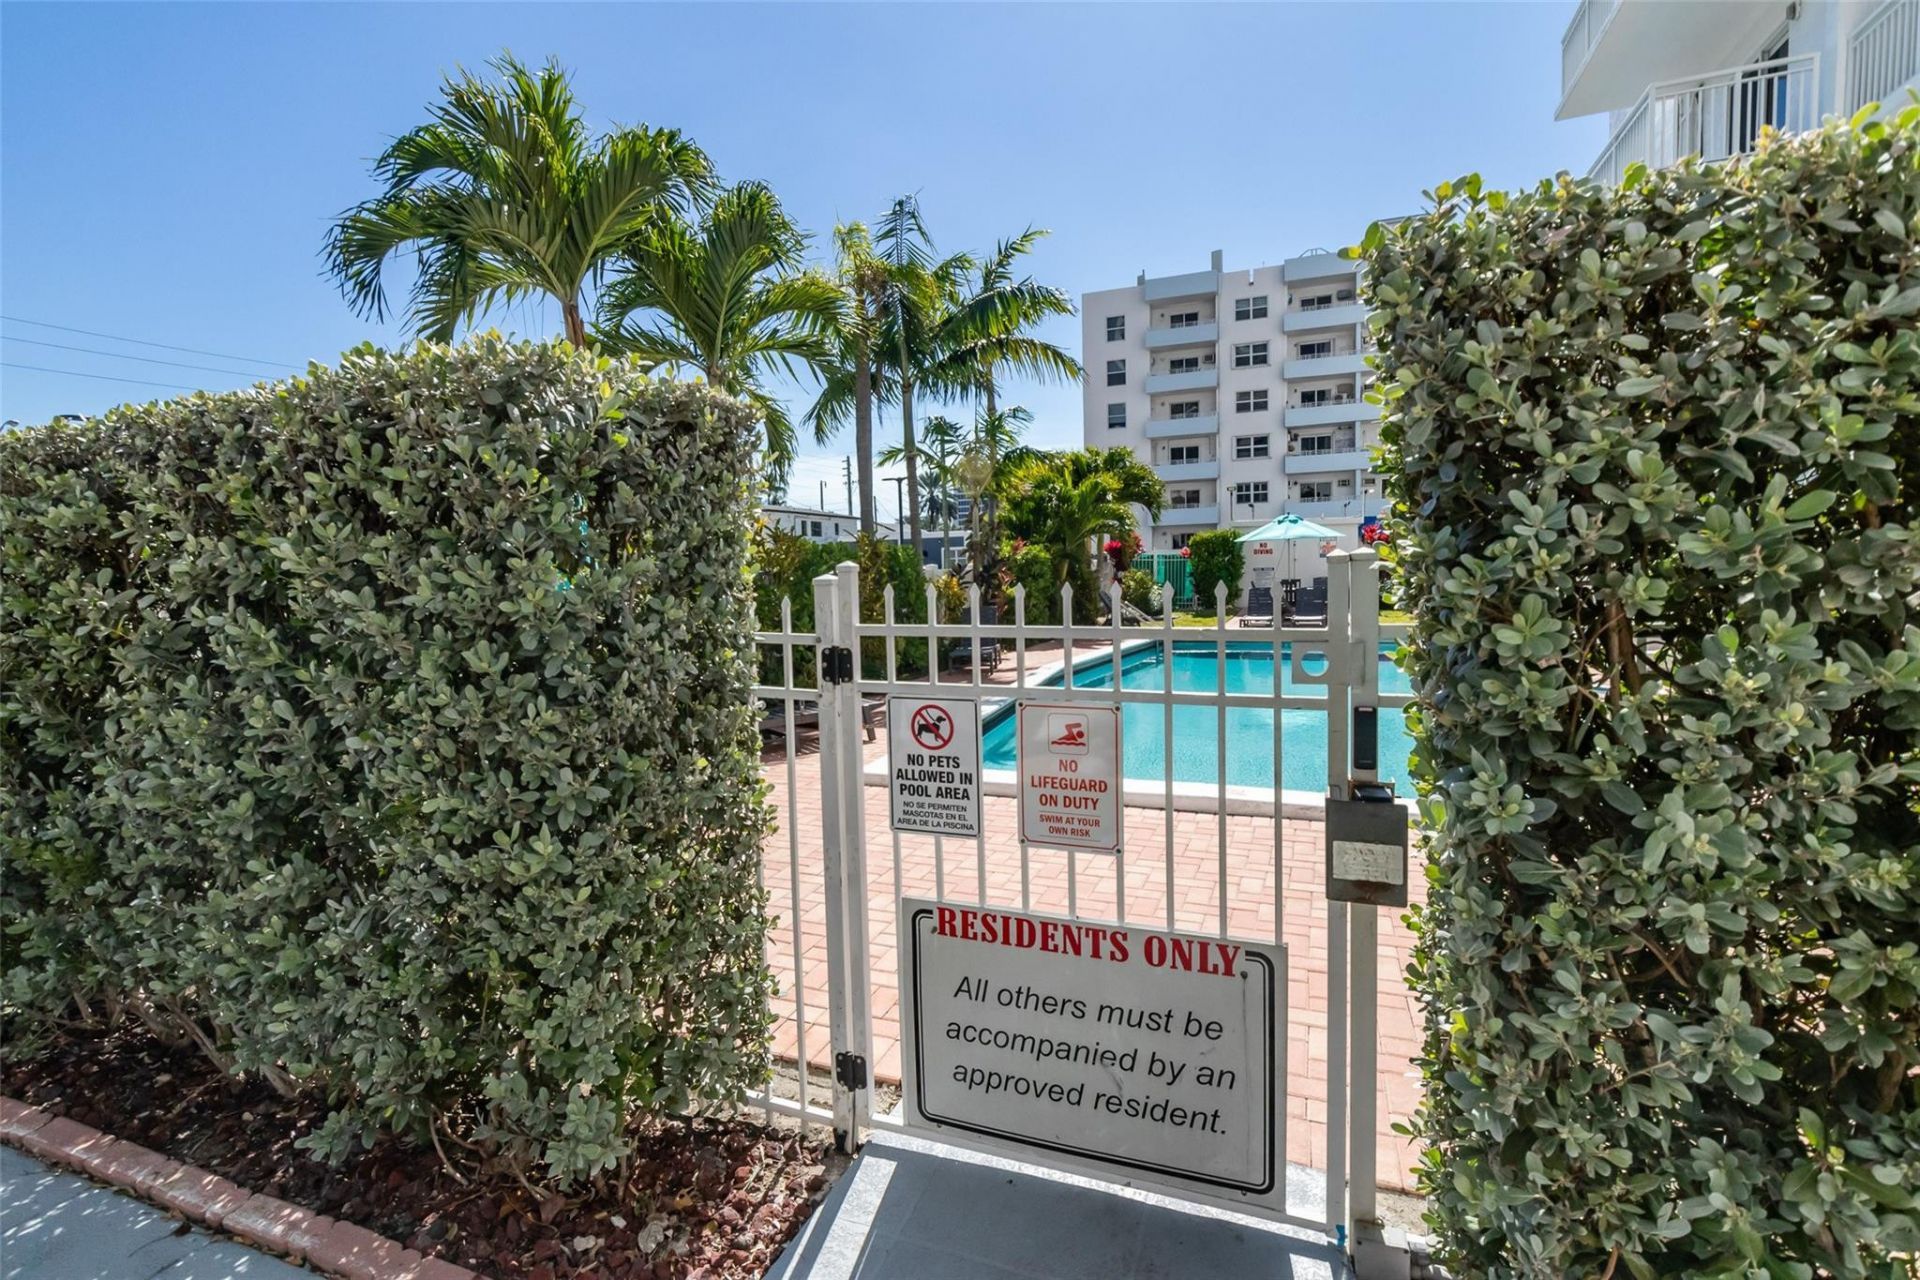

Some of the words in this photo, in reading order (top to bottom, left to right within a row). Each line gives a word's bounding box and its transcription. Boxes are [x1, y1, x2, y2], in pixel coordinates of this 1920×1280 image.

[907, 754, 924, 766] NO
[929, 755, 960, 768] PETS
[1059, 759, 1078, 772] NO
[896, 768, 954, 783] ALLOWED
[960, 773, 972, 785] IN
[1031, 775, 1107, 793] LIFEGUARD
[900, 783, 931, 797] POOL
[936, 787, 970, 800] AREA
[928, 803, 967, 812] PERMITEN
[1040, 794, 1057, 807] ON
[1063, 796, 1099, 810] DUTY
[903, 810, 944, 819] MASCOTAS
[1040, 814, 1063, 824] SWIM
[1077, 818, 1100, 827] YOUR
[897, 817, 917, 825] AREA
[944, 822, 974, 830] PISCINA
[1049, 826, 1068, 835] OWN
[1071, 829, 1090, 837] RISK
[936, 907, 1128, 963] RESIDENTS
[1144, 936, 1240, 977] ONLY
[954, 976, 989, 1002] All
[998, 987, 1086, 1020] others
[1098, 1004, 1173, 1033] must
[1184, 1011, 1224, 1041] be
[946, 1022, 1137, 1073] accompanied
[1148, 1052, 1186, 1086] by
[1196, 1066, 1235, 1090] an
[953, 1064, 1084, 1106] approved
[1095, 1090, 1226, 1135] resident.
